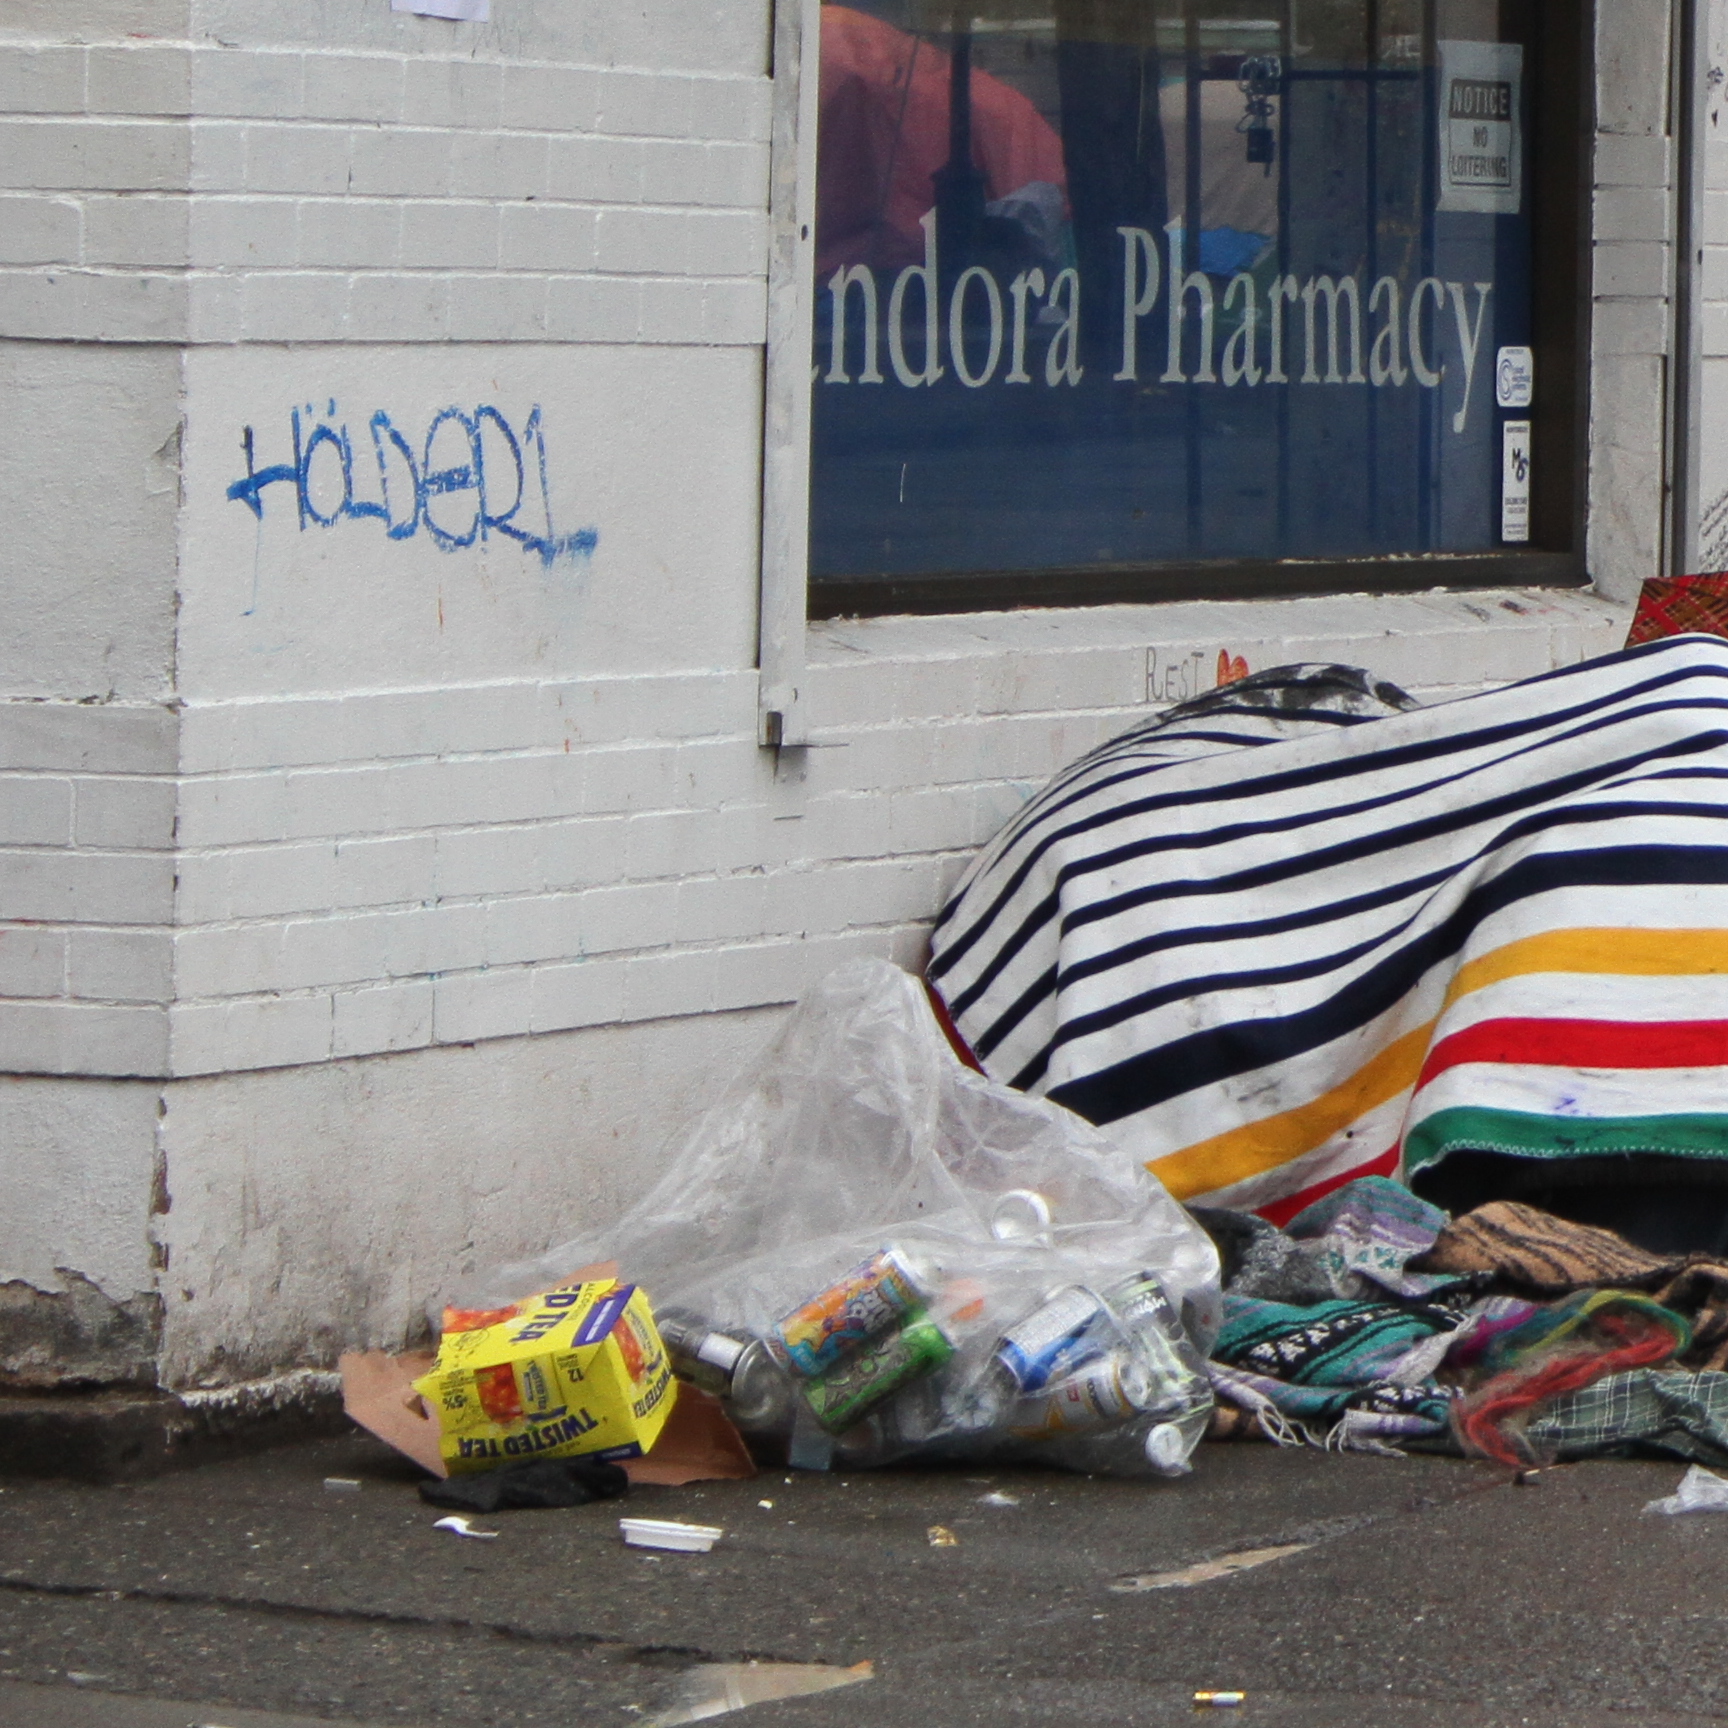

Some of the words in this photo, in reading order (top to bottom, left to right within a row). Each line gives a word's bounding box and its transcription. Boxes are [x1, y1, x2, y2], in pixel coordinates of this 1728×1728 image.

[1452, 85, 1509, 116] NOTICE
[1473, 125, 1488, 149] NO
[1451, 154, 1508, 179] LOITERING
[812, 204, 1085, 389] ndora
[1112, 215, 1492, 435] Pharmacy
[509, 1310, 570, 1343] TEA
[502, 1406, 599, 1457] TWISTED
[457, 1436, 501, 1460] TEA
